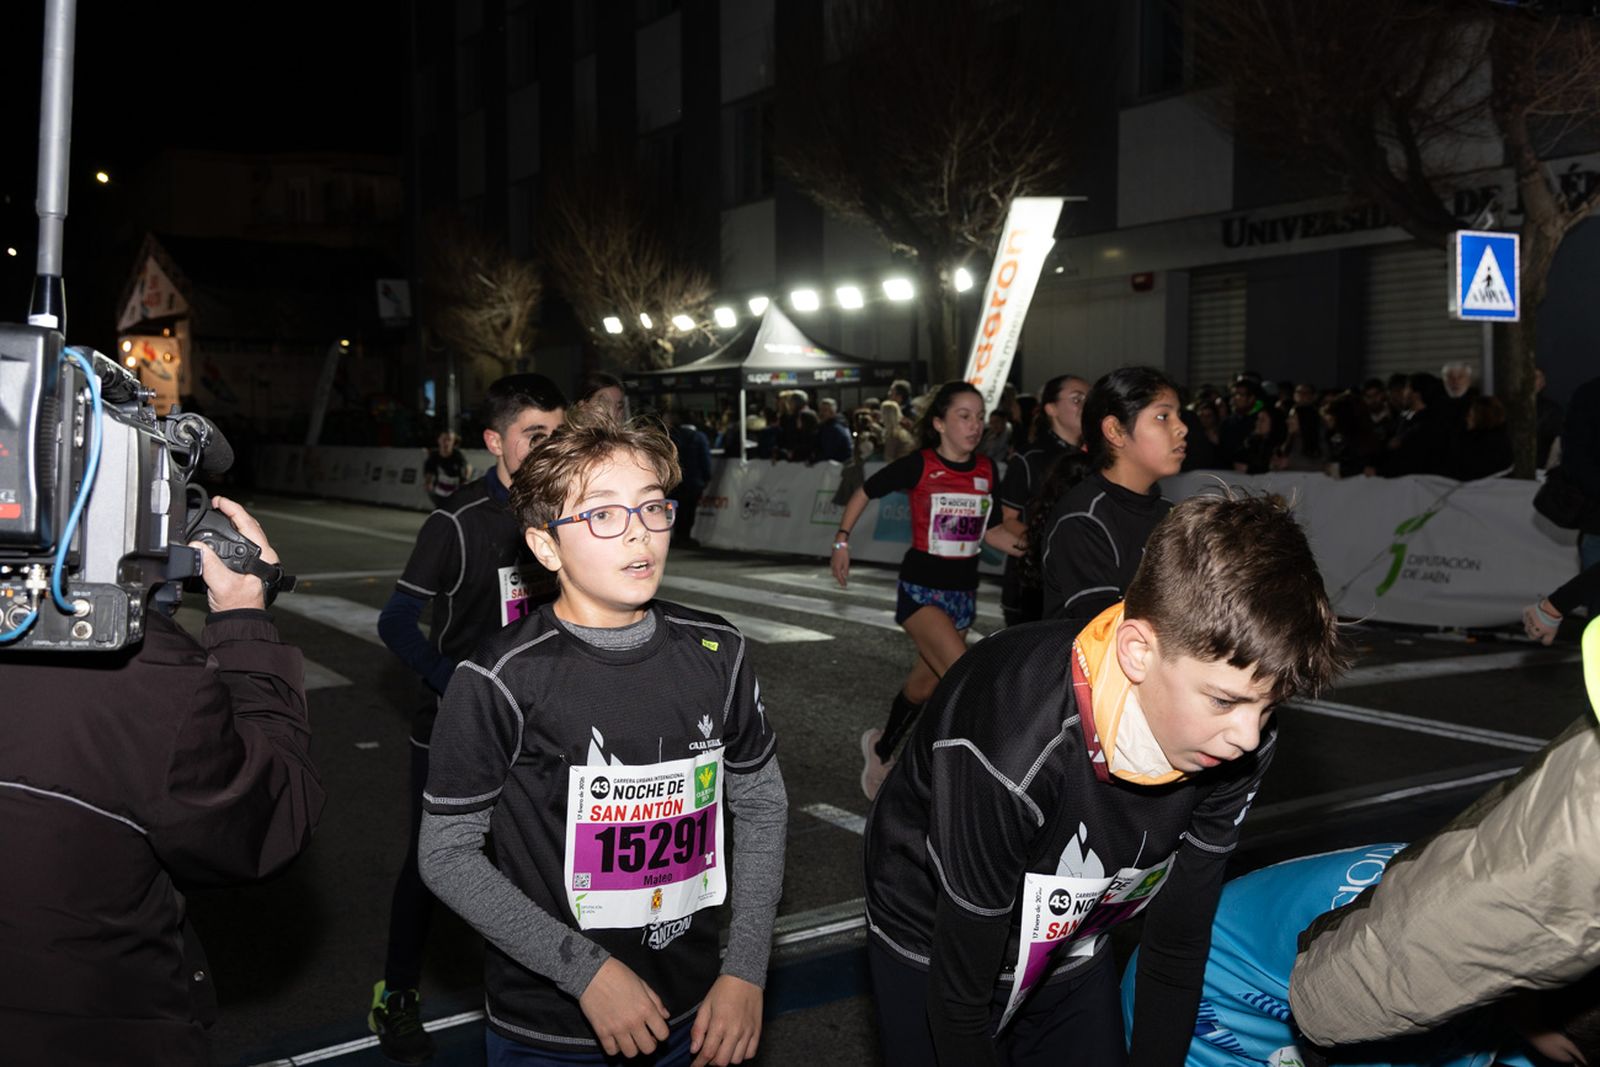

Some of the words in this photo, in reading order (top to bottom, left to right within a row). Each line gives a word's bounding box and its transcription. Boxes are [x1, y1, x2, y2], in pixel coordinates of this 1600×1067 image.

[1407, 554, 1481, 571] DIPUTACIÓN
[591, 781, 608, 793] 43
[613, 782, 665, 800] NOCHE
[667, 779, 685, 795] DE
[590, 805, 627, 822] SAN
[630, 796, 684, 821] ANTÓN
[595, 811, 708, 873] 15291
[643, 872, 673, 886] Mateo
[1050, 895, 1070, 909] 43
[1046, 918, 1081, 940] SAN
